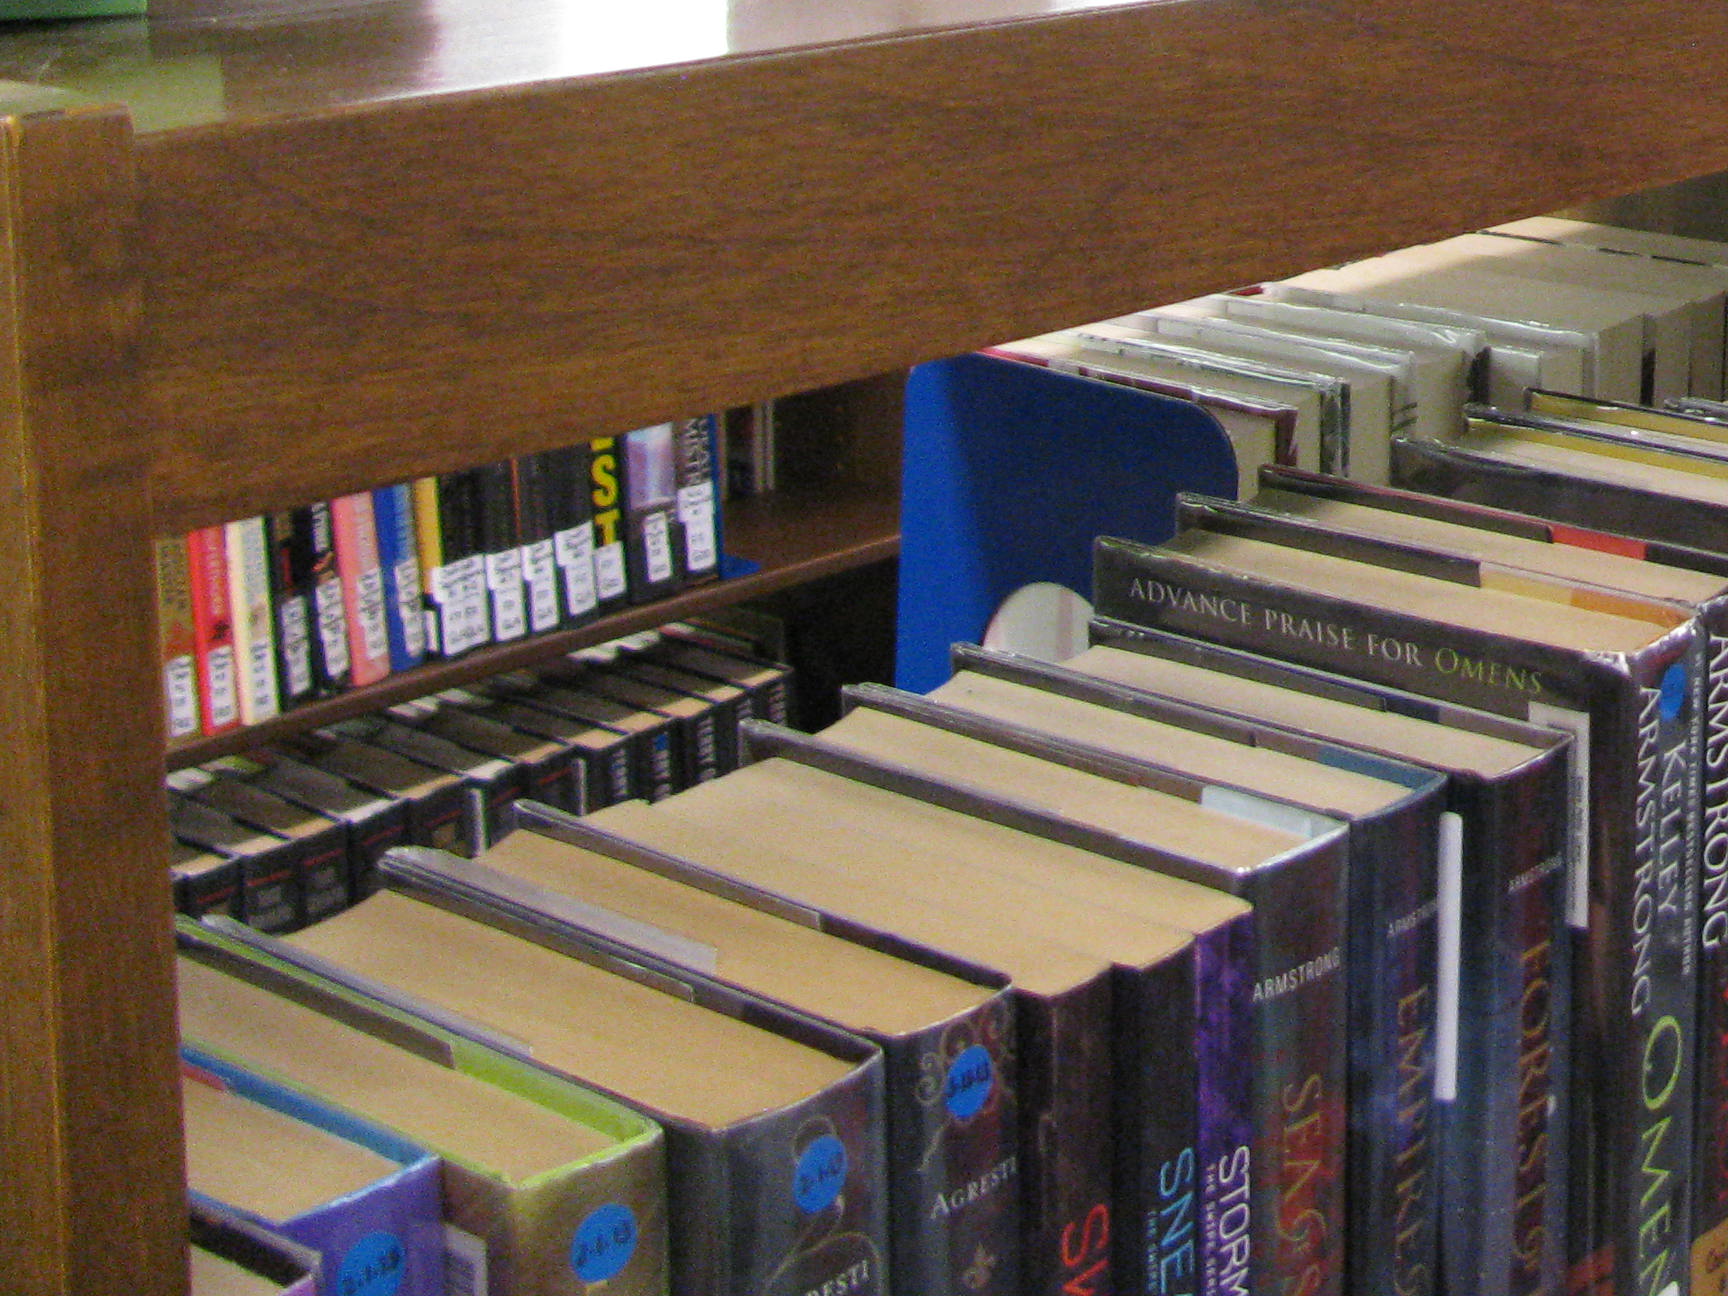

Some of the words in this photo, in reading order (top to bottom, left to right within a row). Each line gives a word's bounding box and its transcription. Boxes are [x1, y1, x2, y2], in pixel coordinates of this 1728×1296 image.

[1129, 576, 1253, 626] ADVANCE
[1263, 608, 1355, 651] PRAISE
[1366, 632, 1422, 668] FOR
[1433, 646, 1543, 695] OMENS
[1631, 686, 1662, 1017] ARMSTRONG
[1657, 741, 1687, 915] KELLEY
[1252, 946, 1341, 1004] ARMSTRONG
[929, 1156, 1018, 1220] AGRESTI
